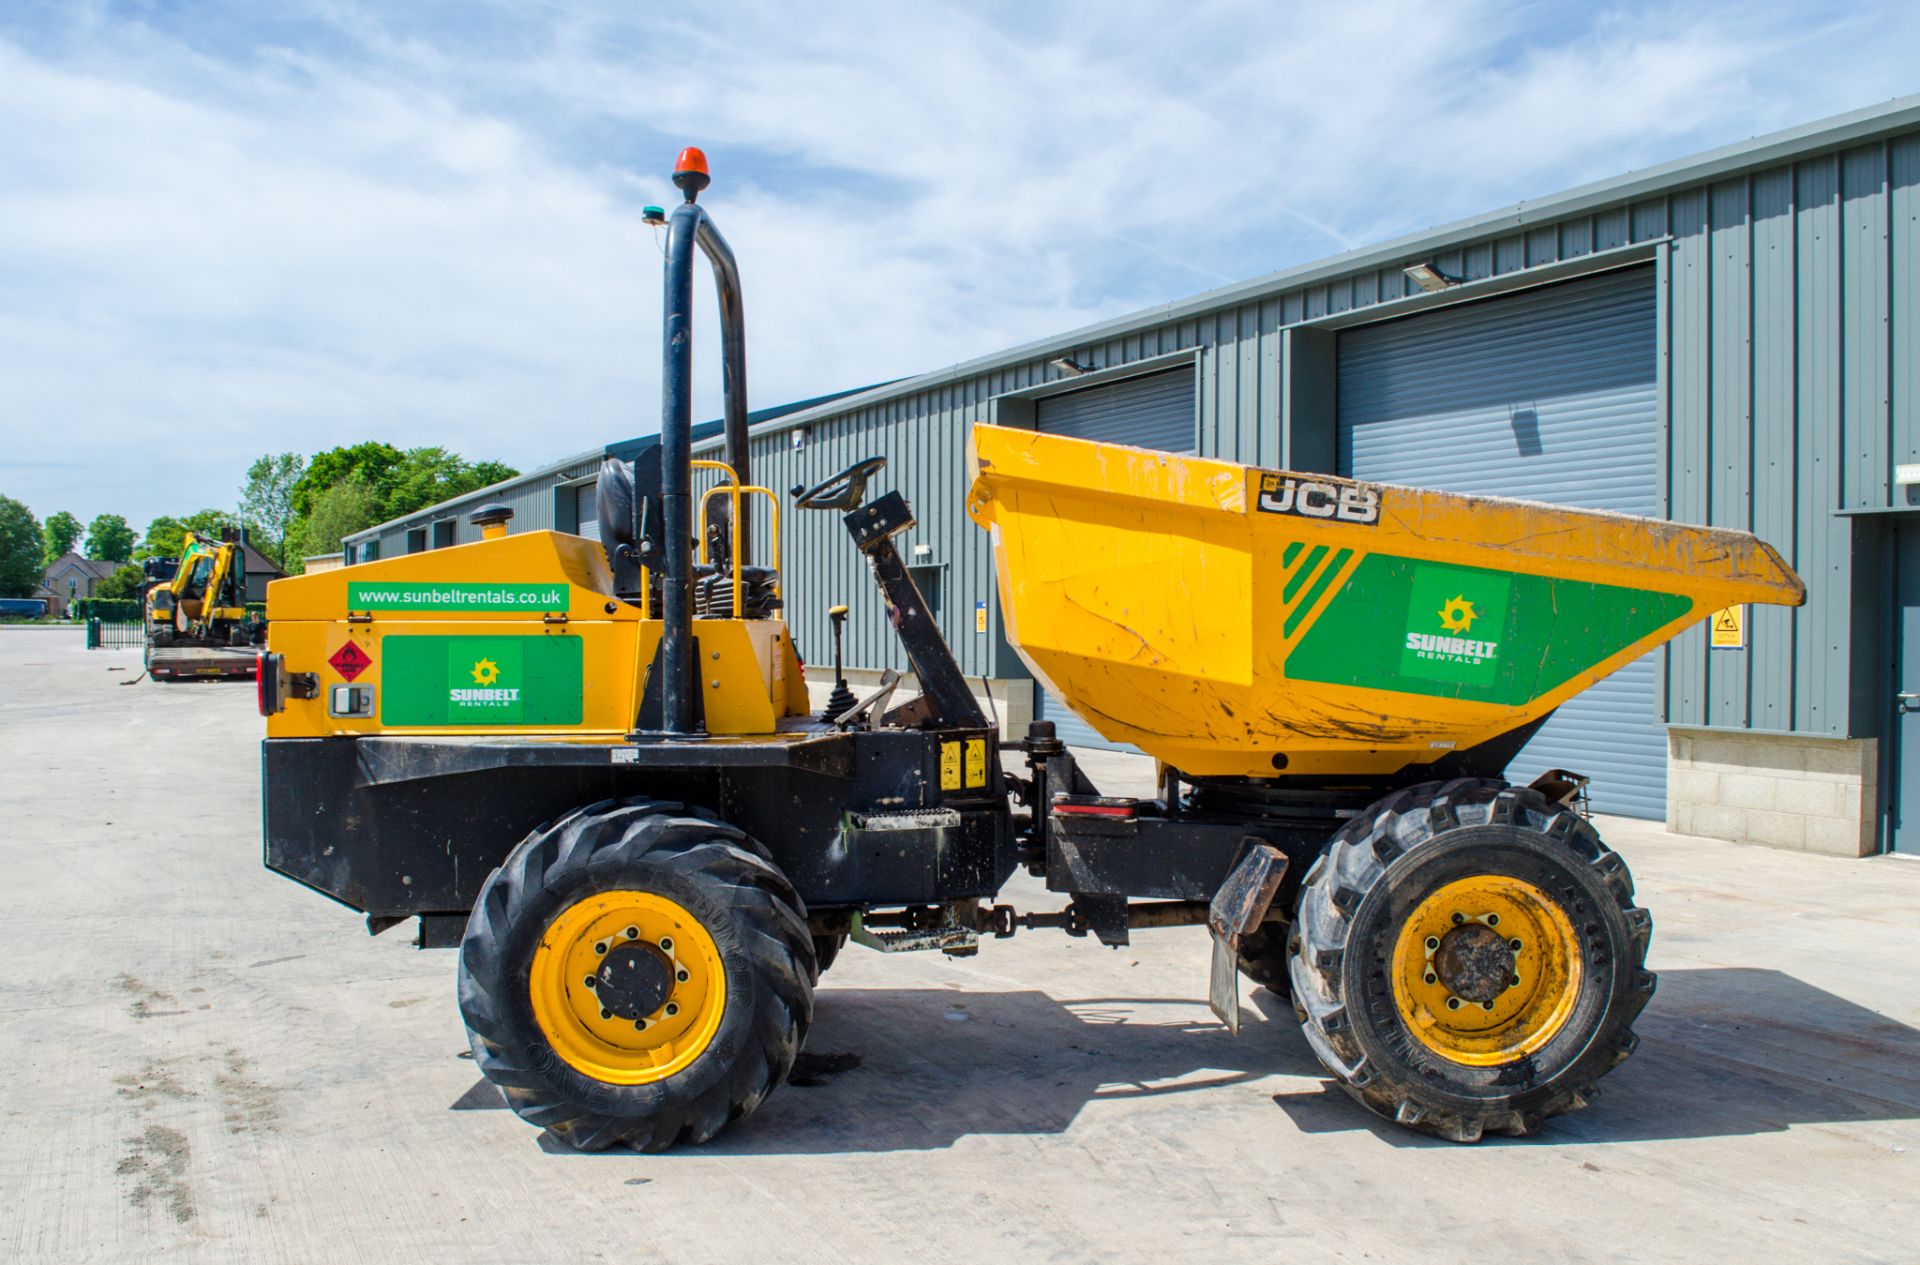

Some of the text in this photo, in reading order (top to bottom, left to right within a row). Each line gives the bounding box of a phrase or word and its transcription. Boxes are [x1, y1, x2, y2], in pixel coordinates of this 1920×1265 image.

[1261, 479, 1378, 523] JCB
[359, 589, 561, 604] www.sunbeltrentals.co.uk
[1406, 632, 1498, 659] SUNBELT
[1417, 651, 1482, 665] RENTALS
[450, 688, 520, 702] SUNBELT
[693, 894, 753, 1008] DUMPER
